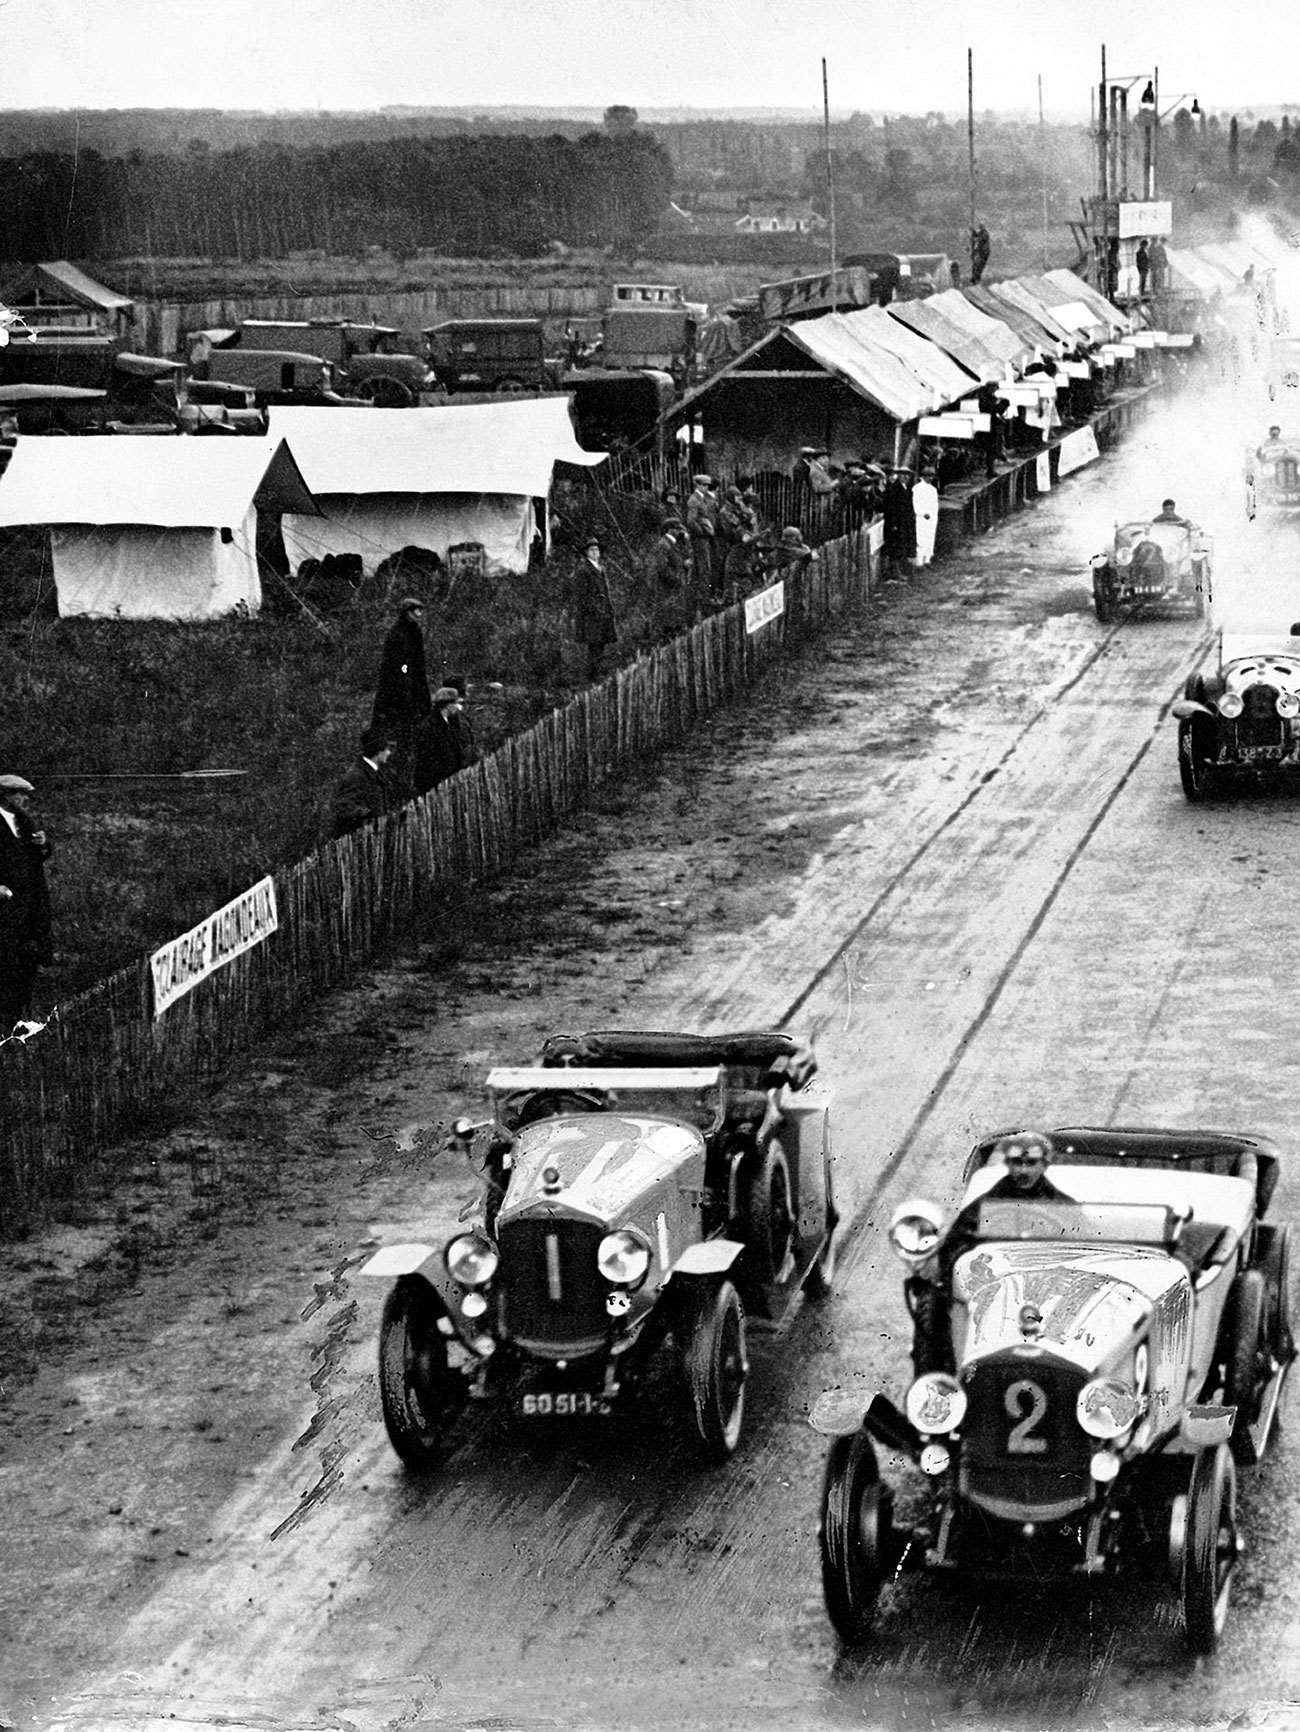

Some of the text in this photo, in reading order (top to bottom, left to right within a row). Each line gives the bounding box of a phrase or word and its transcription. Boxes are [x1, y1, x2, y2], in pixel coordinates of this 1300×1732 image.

[546, 1233, 562, 1301] 1
[656, 1211, 669, 1272] 1
[1005, 1379, 1047, 1453] 2
